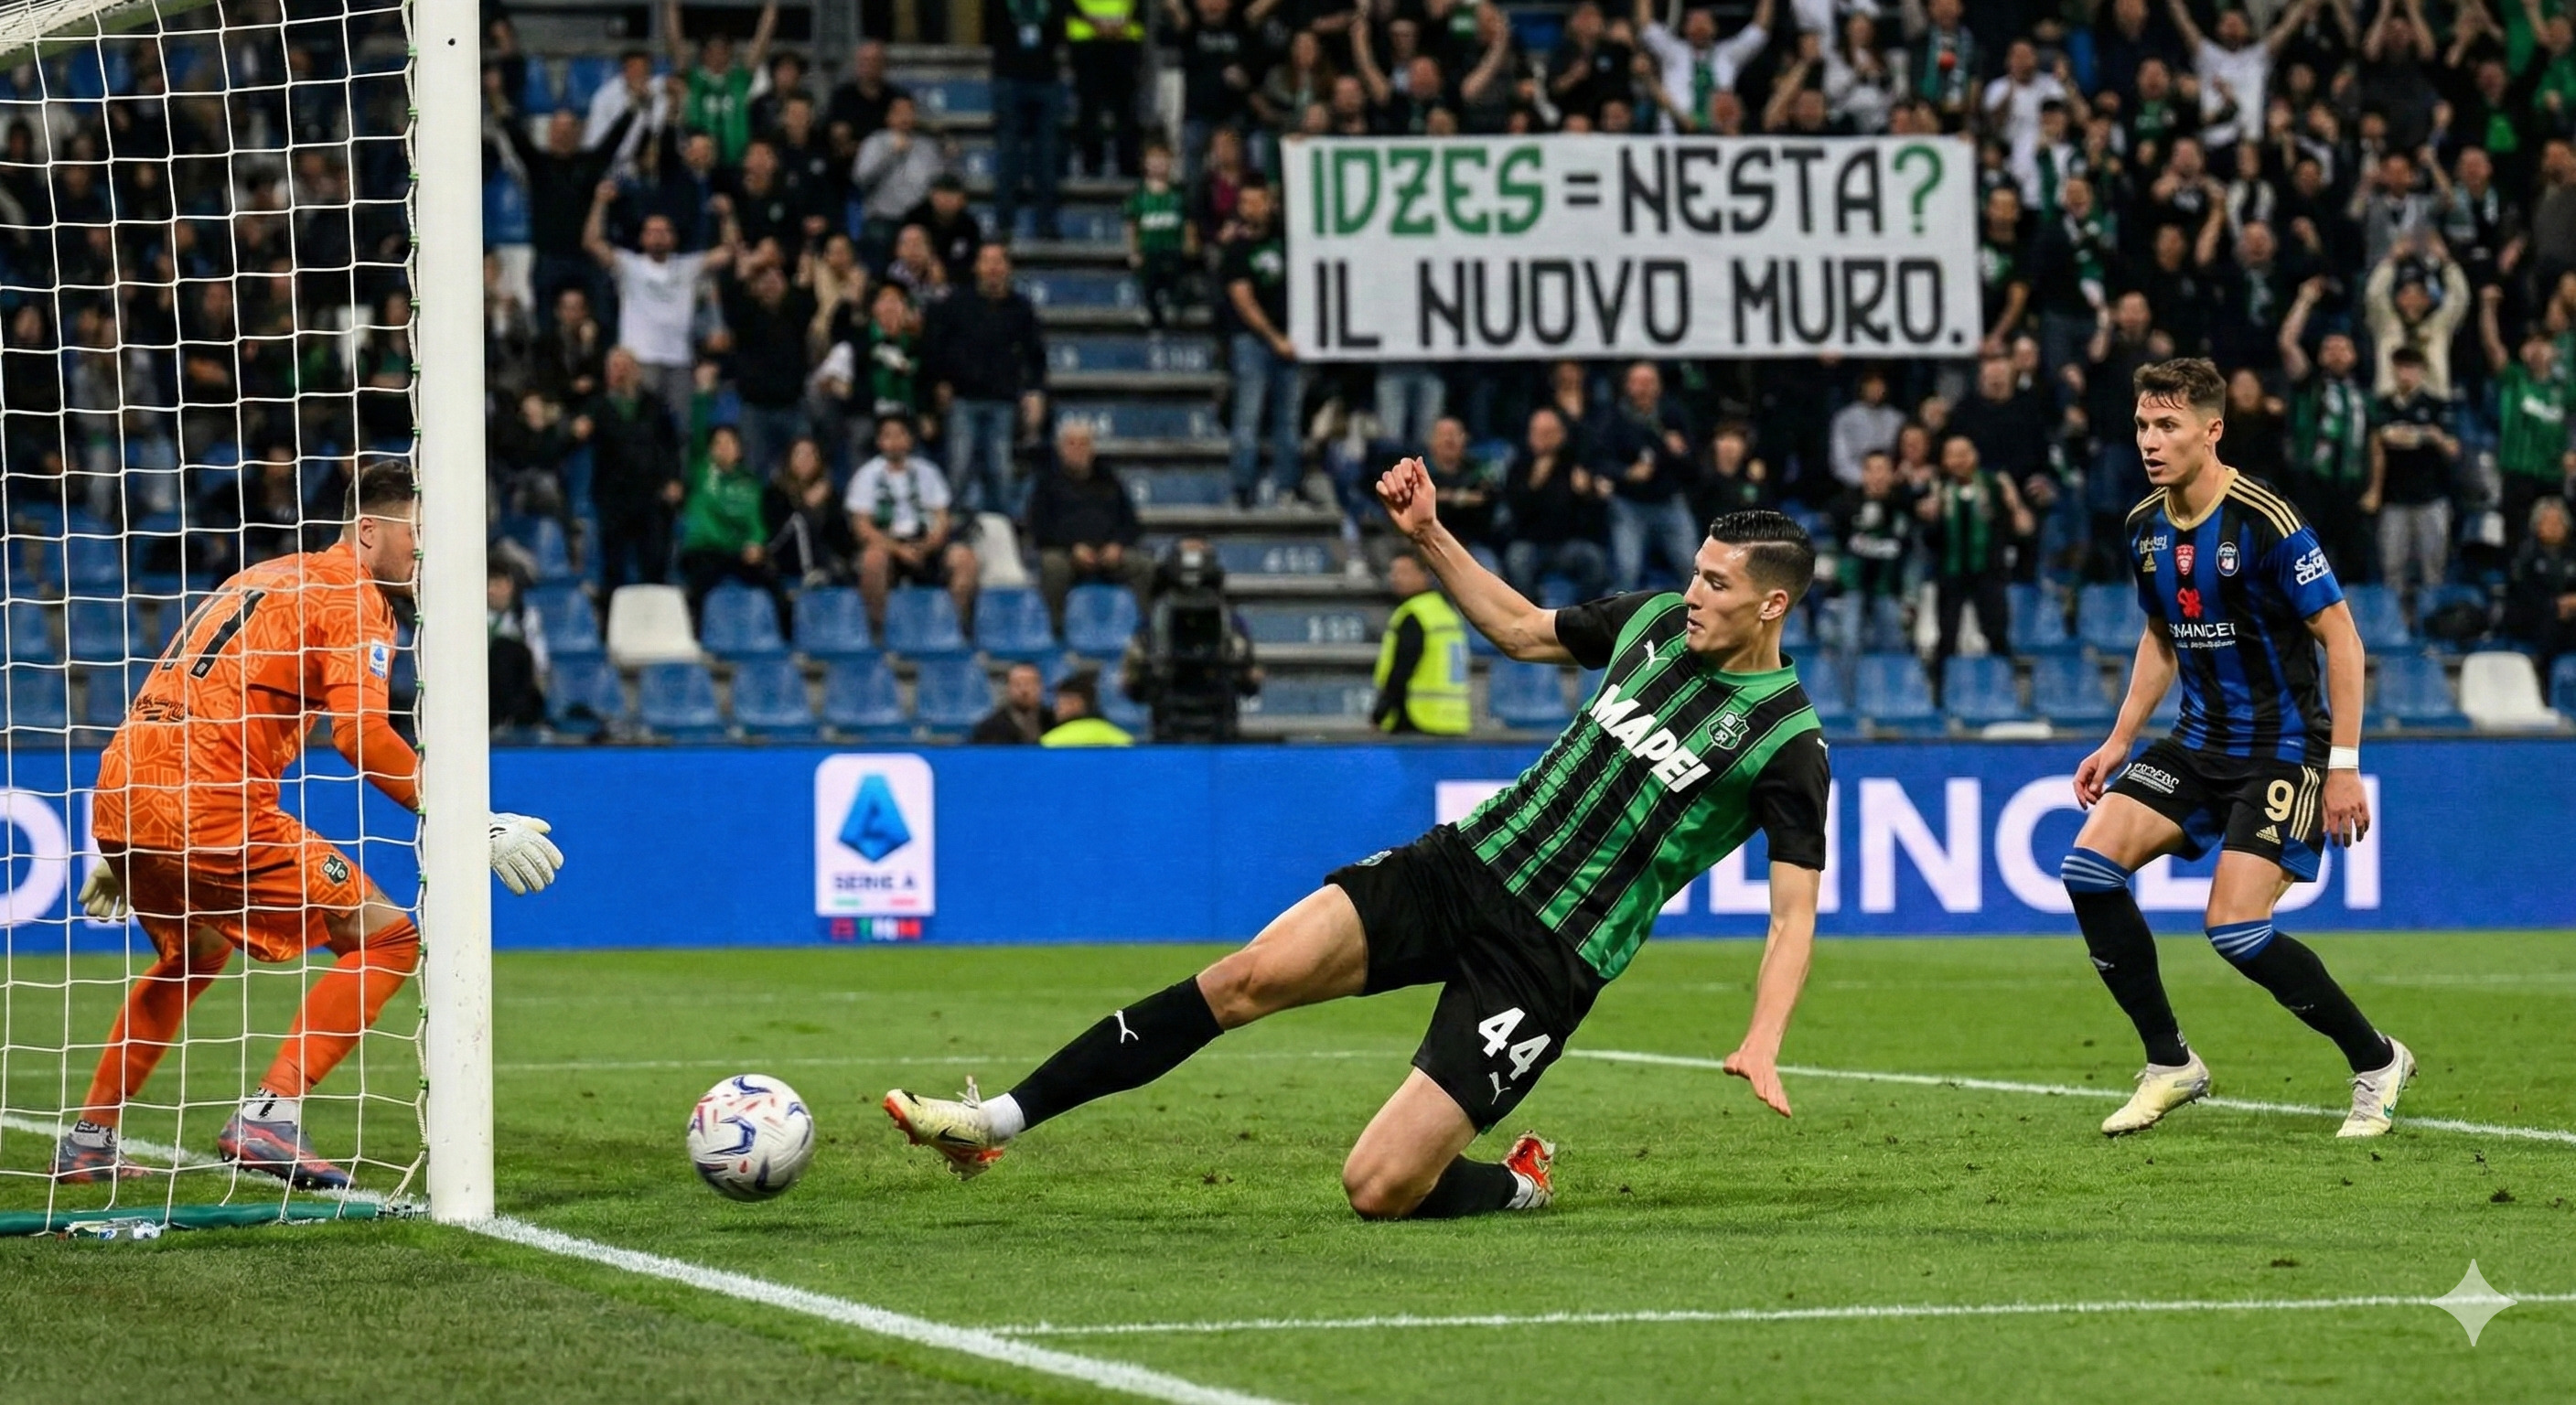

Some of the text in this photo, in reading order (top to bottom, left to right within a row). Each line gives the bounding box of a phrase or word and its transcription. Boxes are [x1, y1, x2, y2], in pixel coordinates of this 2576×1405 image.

[1311, 146, 1546, 235] IDZES
[1620, 145, 1945, 235] NESTA?
[1315, 258, 1964, 349] IL NUOVO MURO.
[1590, 684, 1712, 793] MAPEI
[2265, 779, 2295, 821] 9
[1478, 1007, 1551, 1081] 44
